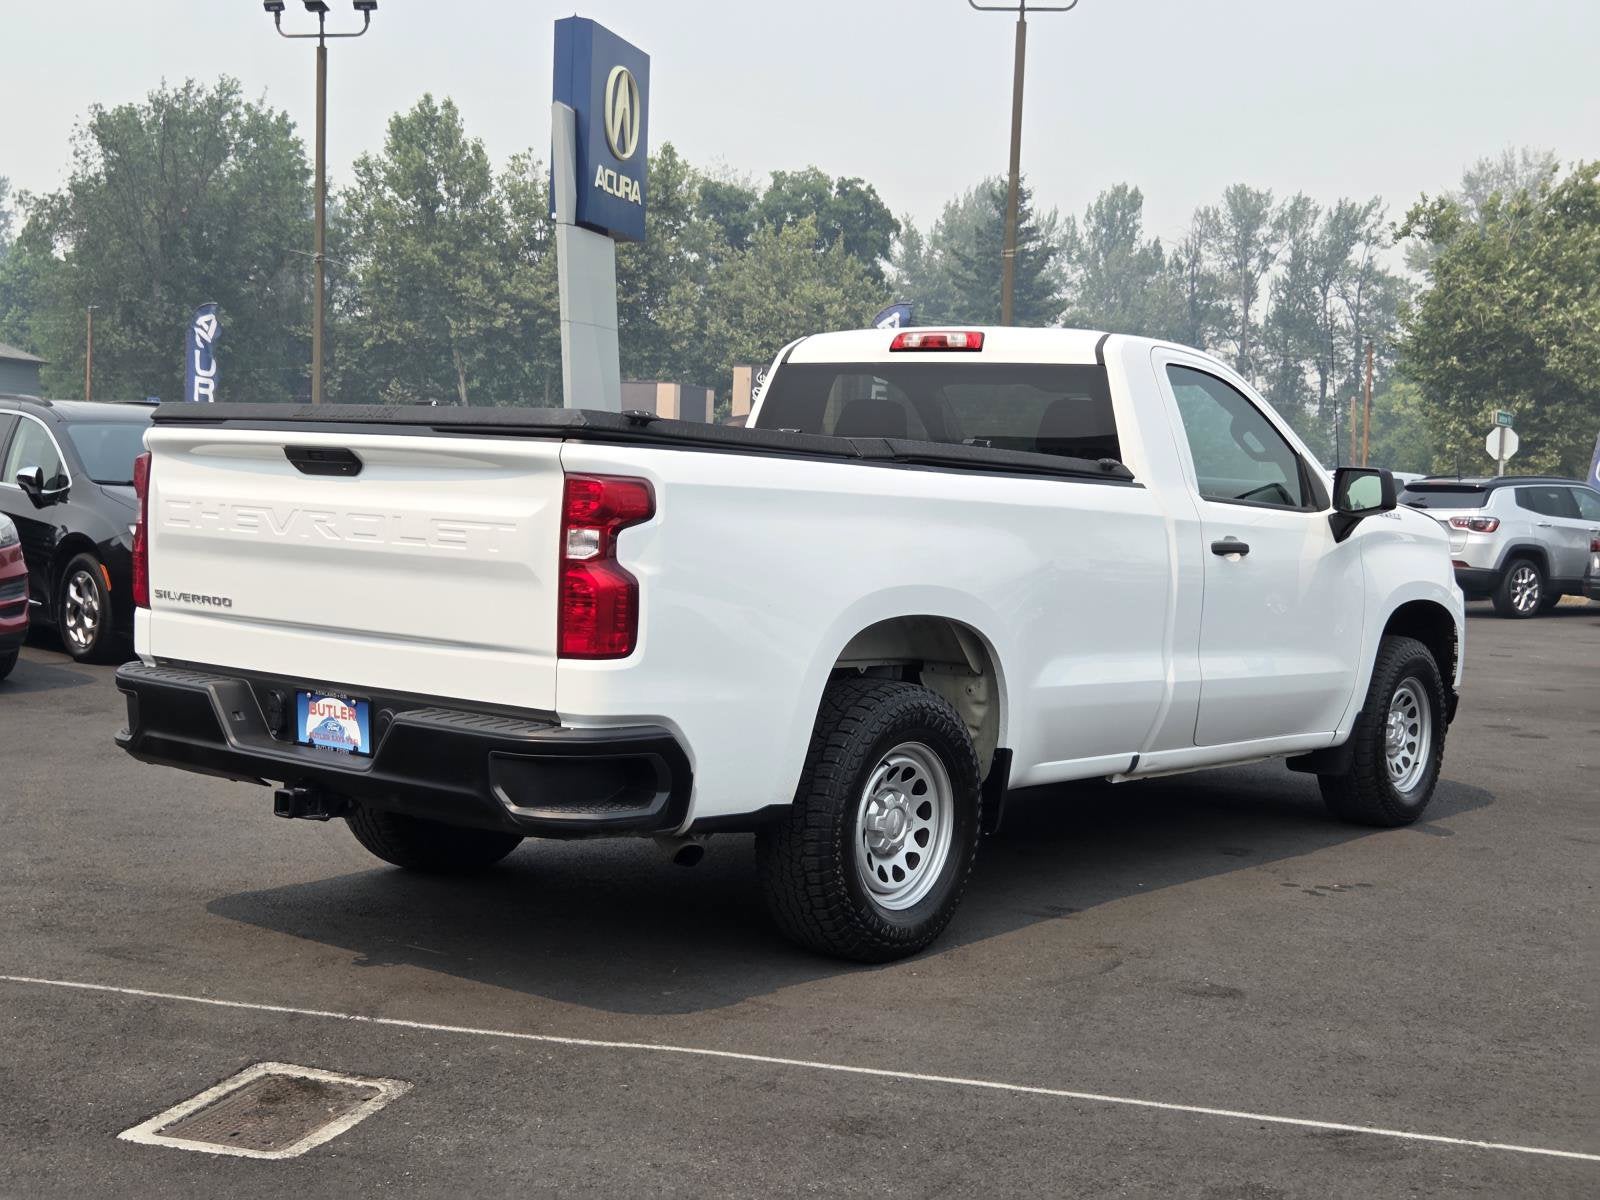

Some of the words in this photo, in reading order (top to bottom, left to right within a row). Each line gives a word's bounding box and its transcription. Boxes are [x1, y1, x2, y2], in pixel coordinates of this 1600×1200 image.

[593, 164, 642, 205] ACURA
[193, 313, 218, 403] ACUR
[163, 499, 517, 553] CHEVROLET
[154, 588, 233, 608] SILVERADO
[309, 701, 357, 721] BUTLER
